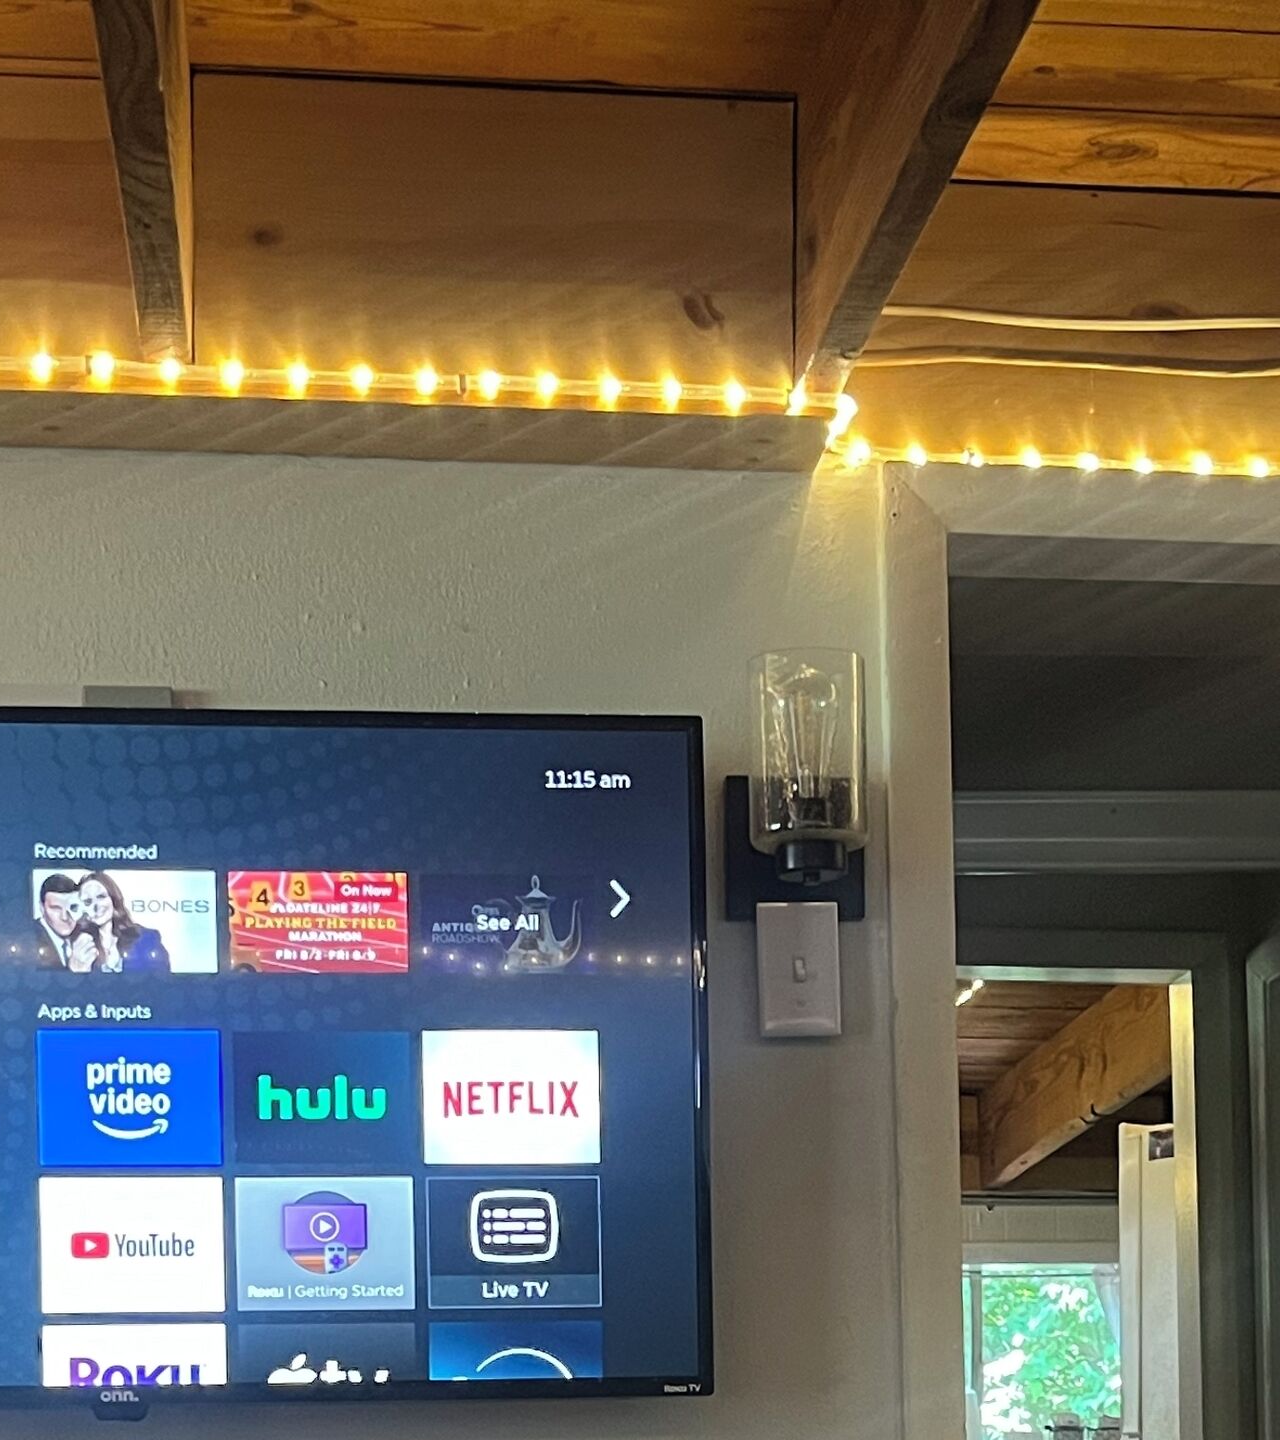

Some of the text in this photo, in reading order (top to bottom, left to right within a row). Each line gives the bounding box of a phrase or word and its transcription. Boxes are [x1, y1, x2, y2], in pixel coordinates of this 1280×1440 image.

[545, 770, 631, 789] 11:15 am
[34, 843, 158, 860] Recommended
[256, 888, 269, 906] 4
[293, 881, 305, 896] 3
[341, 885, 393, 897] On Now
[131, 900, 209, 913] BONES
[245, 917, 312, 929] PLAYING
[477, 914, 539, 931] See All
[289, 931, 362, 942] MARATHON
[38, 1004, 153, 1021] Apps & Inputs
[86, 1057, 172, 1090] prime
[88, 1087, 172, 1115] video
[257, 1074, 388, 1120] hulu
[443, 1080, 579, 1118] NETFLIX
[114, 1232, 195, 1258] YouTube
[294, 1285, 348, 1299] Getting
[351, 1284, 404, 1297] Started
[481, 1281, 549, 1299] Live TV
[688, 1383, 701, 1392] TV
